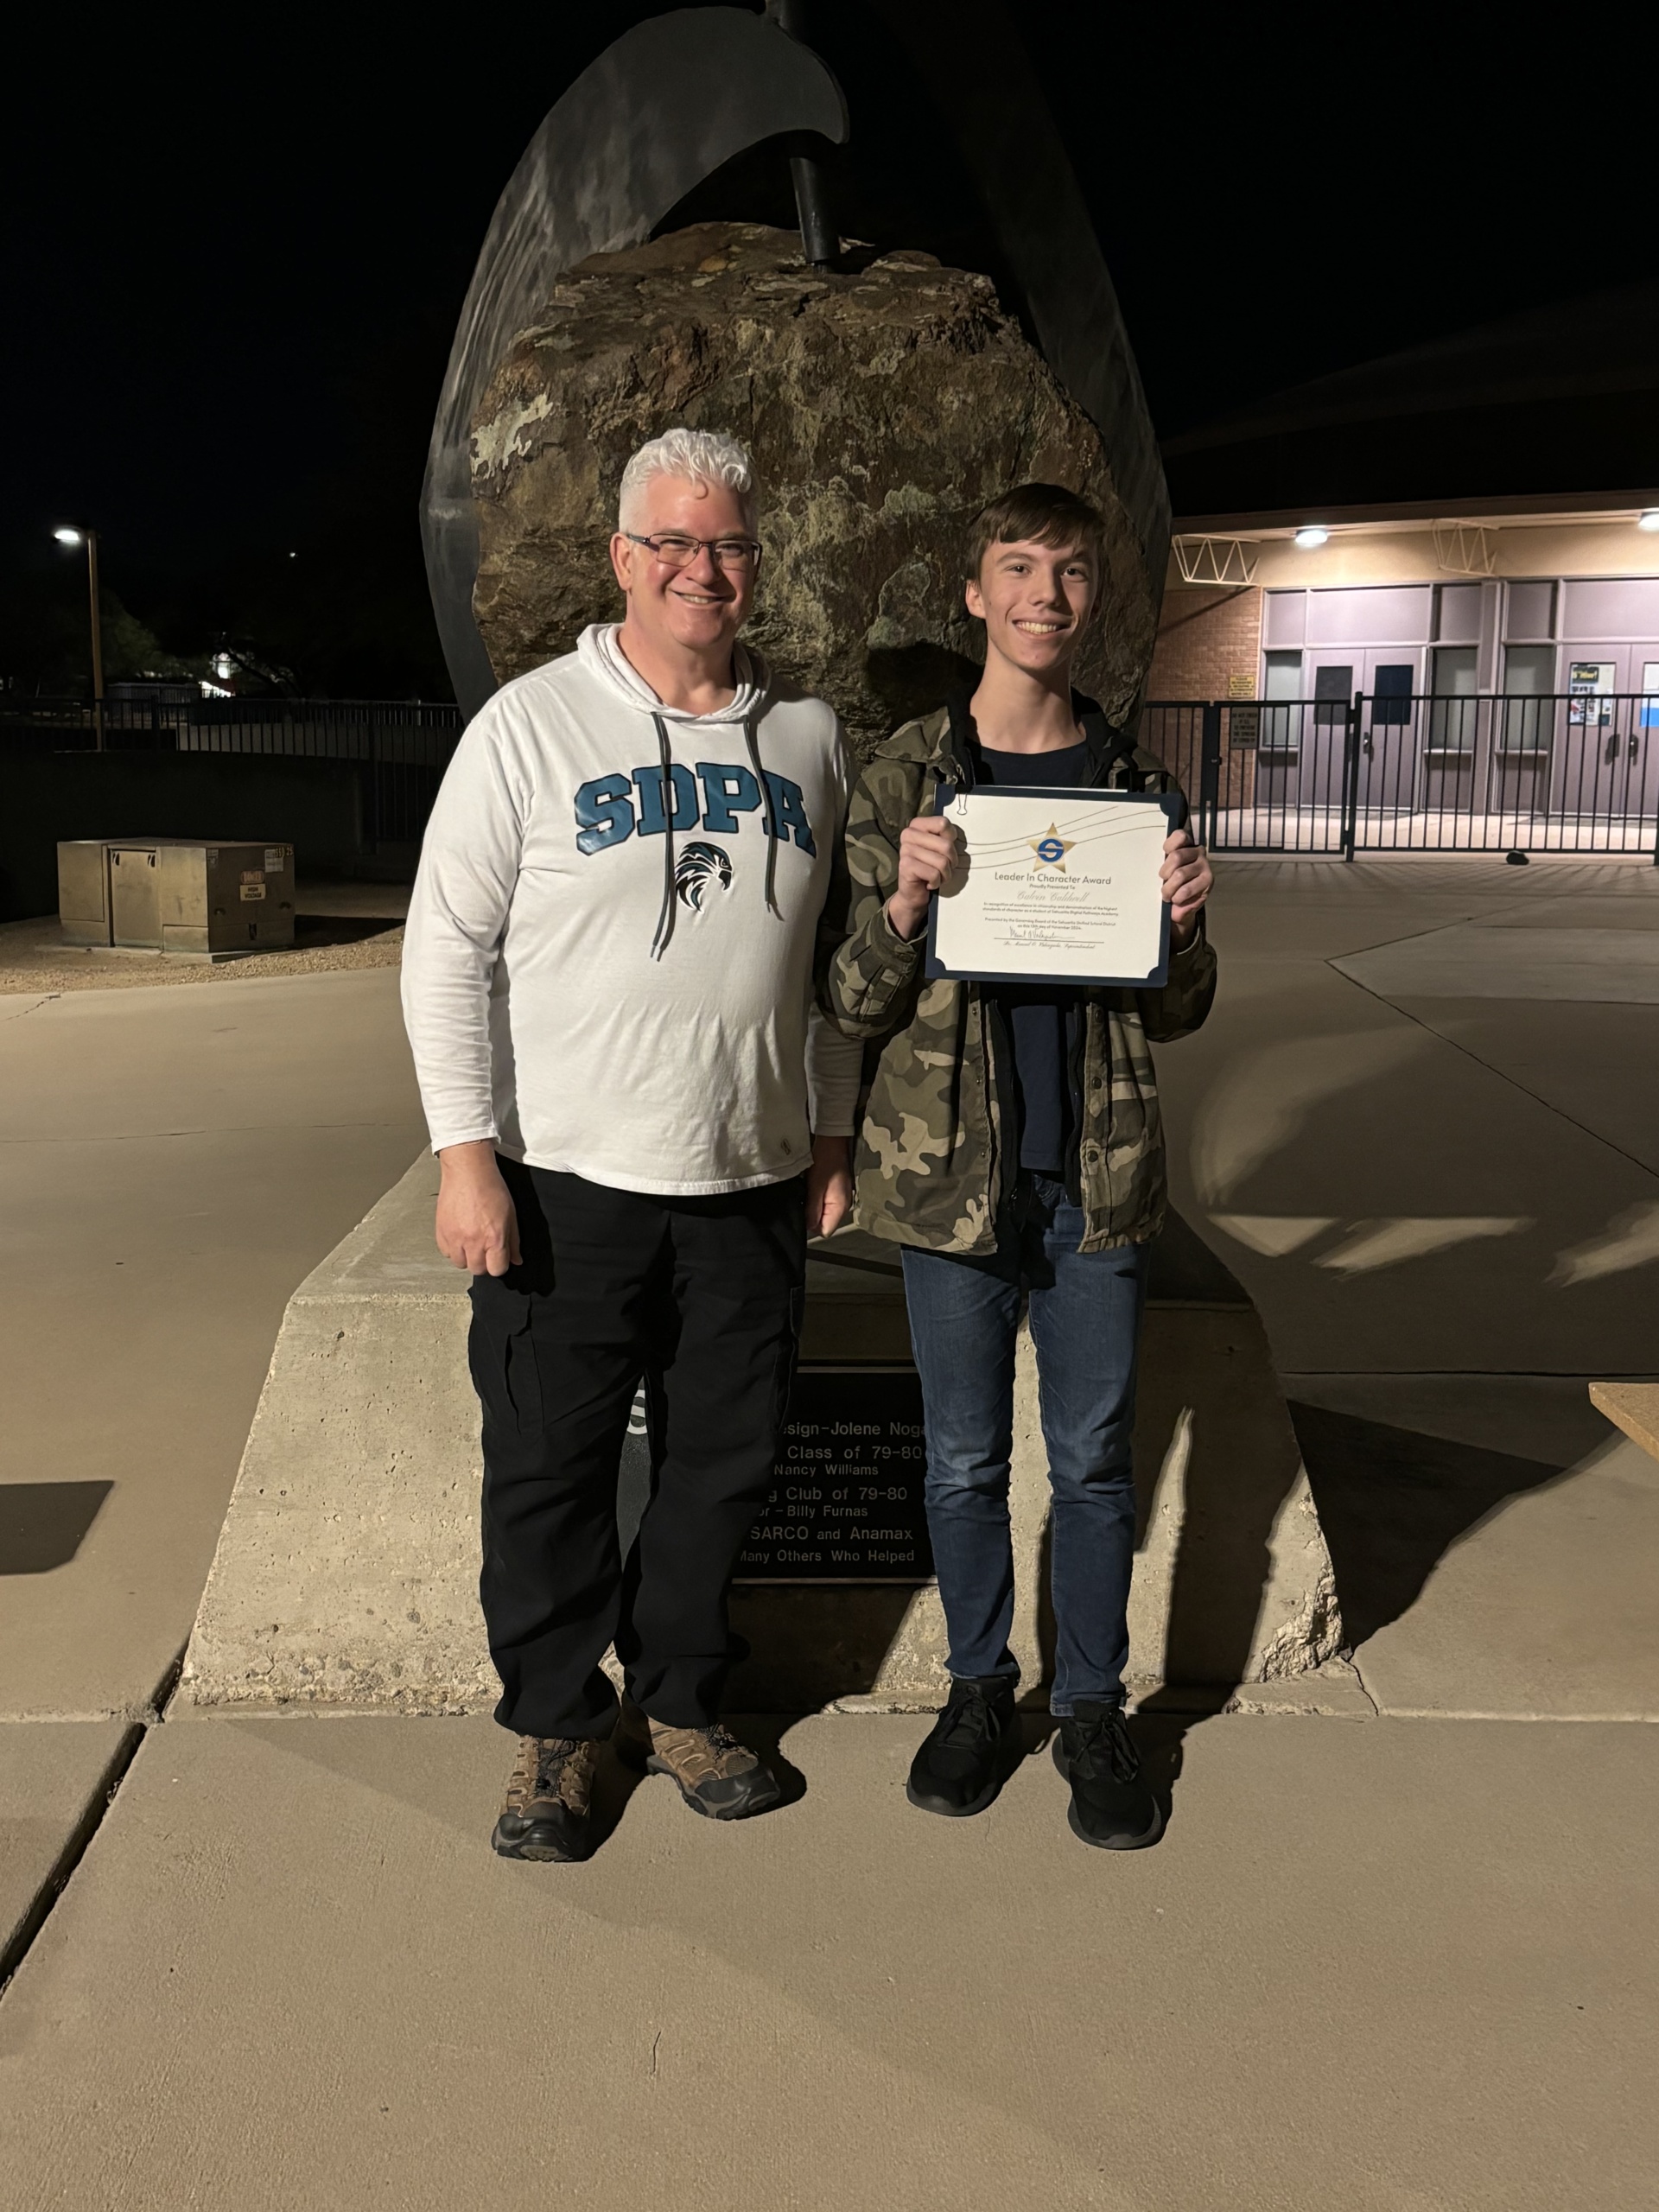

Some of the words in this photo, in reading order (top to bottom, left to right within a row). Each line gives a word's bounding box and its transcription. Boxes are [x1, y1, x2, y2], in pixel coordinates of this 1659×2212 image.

[575, 762, 817, 859] SDPA
[995, 872, 1025, 880] Leader
[1027, 873, 1035, 881] In
[1037, 874, 1081, 883] Character
[1082, 875, 1111, 885] Award
[783, 1421, 881, 1438] sign-Jolene
[787, 1445, 832, 1459] Class
[843, 1445, 861, 1459] of
[871, 1446, 922, 1459] 79-80
[774, 1464, 817, 1478] Nancy
[825, 1464, 879, 1476] Williams
[786, 1487, 822, 1501] Club
[832, 1487, 849, 1501] of
[859, 1487, 908, 1501] 79-80
[787, 1506, 816, 1519] Billy
[823, 1506, 868, 1517] Furnas
[750, 1526, 809, 1540] SARCO
[817, 1529, 841, 1540] and
[850, 1526, 913, 1540] Anamax
[777, 1550, 822, 1561] Others
[831, 1550, 860, 1561] Who
[868, 1550, 915, 1564] Helped
